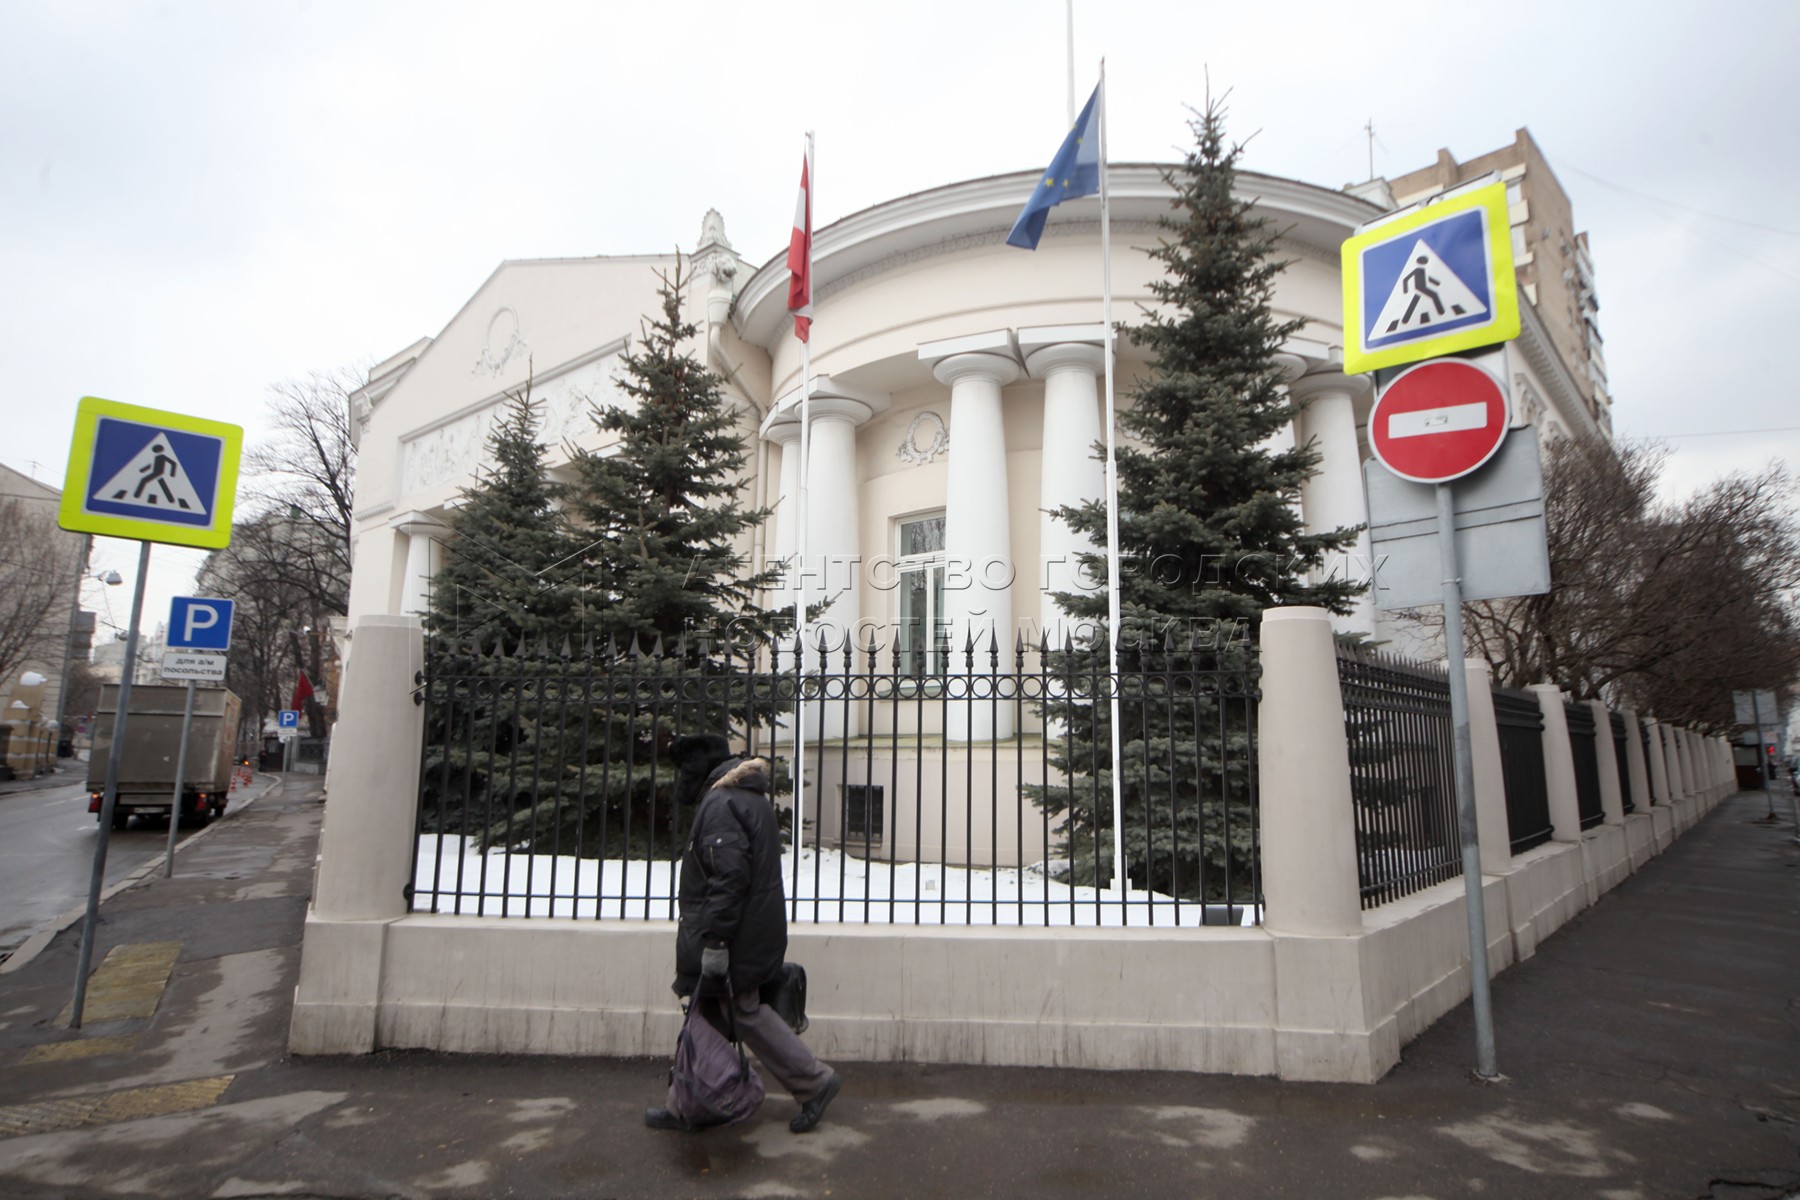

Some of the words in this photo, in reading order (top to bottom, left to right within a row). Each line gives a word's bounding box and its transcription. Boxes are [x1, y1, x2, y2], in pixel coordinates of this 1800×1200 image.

[184, 603, 218, 642] P
[164, 667, 222, 675] посольства
[283, 712, 294, 725] P
